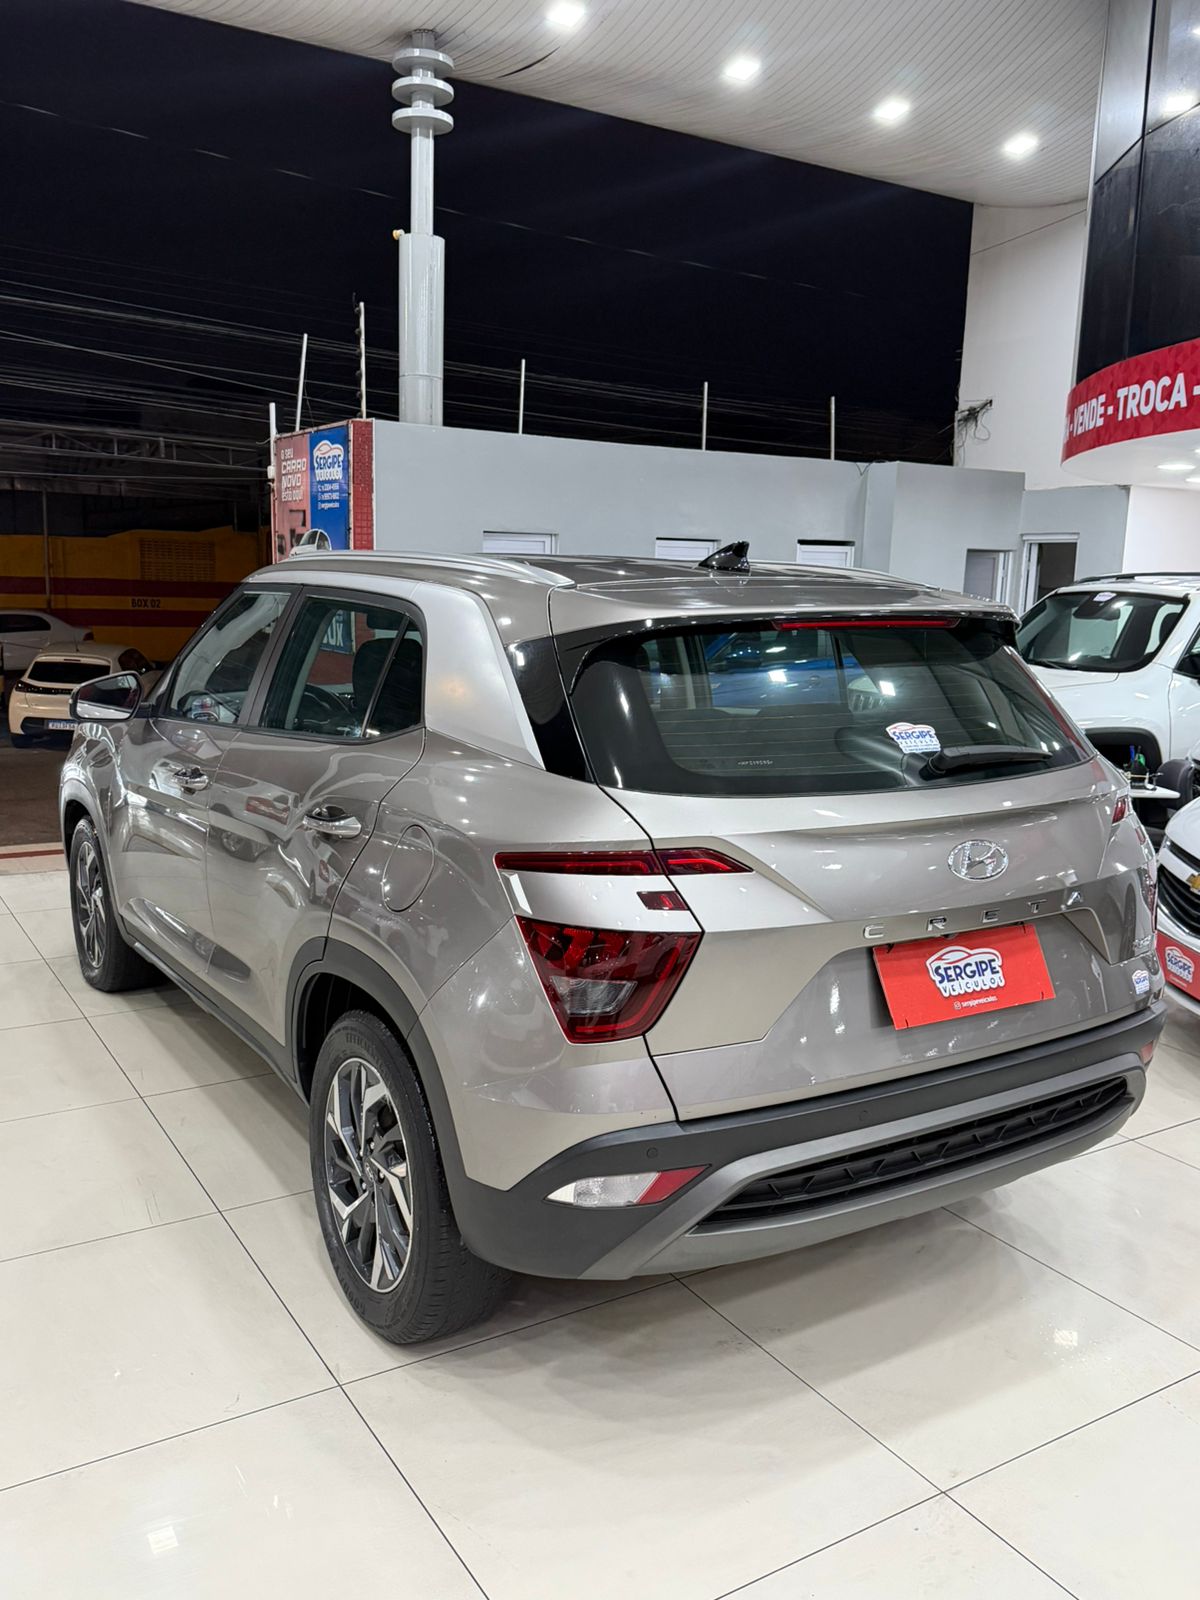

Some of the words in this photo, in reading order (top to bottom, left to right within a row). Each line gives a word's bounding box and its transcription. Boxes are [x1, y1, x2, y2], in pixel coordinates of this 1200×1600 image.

[1073, 393, 1106, 437] VENDE
[1117, 372, 1187, 421] TROCA
[281, 458, 307, 474] CARRO
[315, 454, 342, 470] SERGIPE
[281, 473, 302, 489] NOVO
[131, 598, 150, 609] BOX
[150, 598, 161, 609] 02
[892, 730, 935, 741] SERGIPE
[863, 890, 1084, 940] CRETA
[933, 958, 1000, 984] SERGIPE
